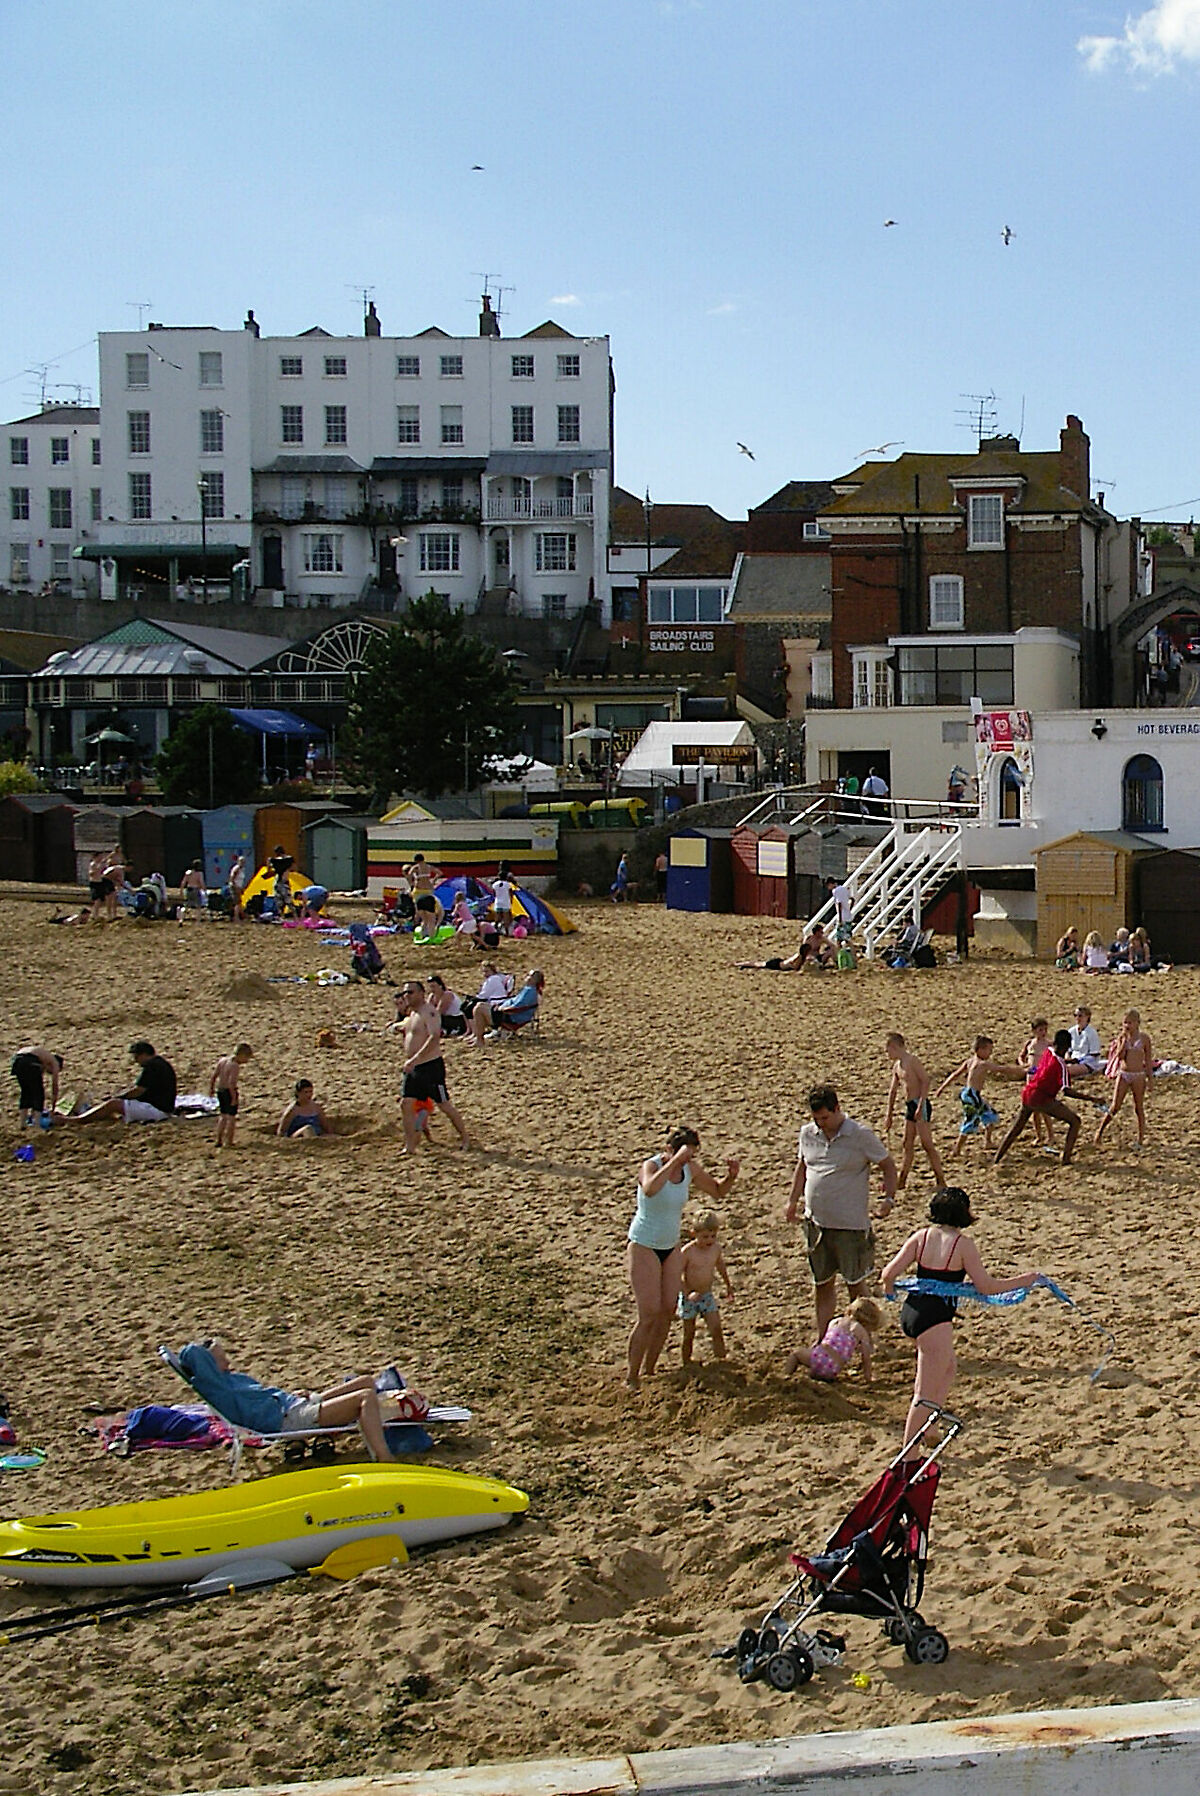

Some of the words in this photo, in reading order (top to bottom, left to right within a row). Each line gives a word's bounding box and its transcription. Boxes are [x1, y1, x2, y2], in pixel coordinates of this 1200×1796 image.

[649, 630, 714, 641] BROADSTAIRS
[649, 642, 685, 652] SAILING
[690, 642, 715, 652] CLUB
[1137, 724, 1155, 735] HOT
[679, 746, 699, 756] THE
[704, 746, 749, 757] PAVILION
